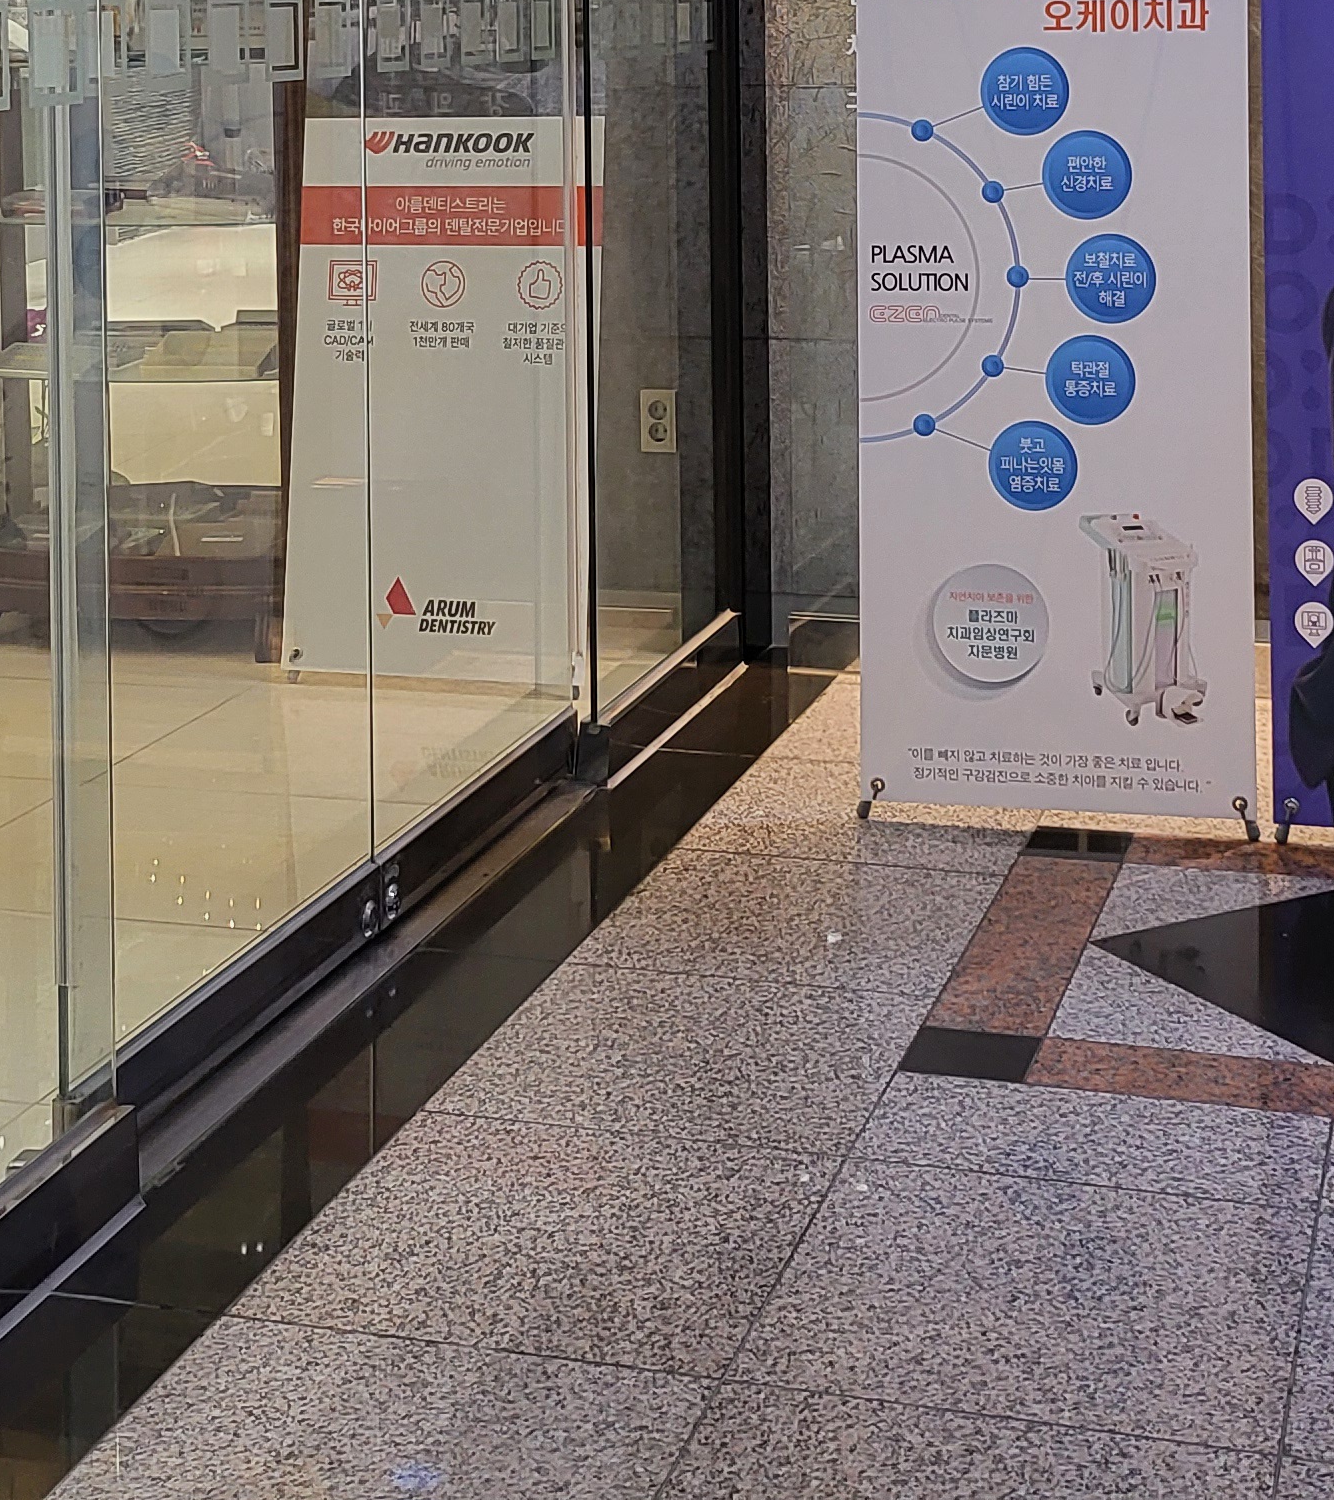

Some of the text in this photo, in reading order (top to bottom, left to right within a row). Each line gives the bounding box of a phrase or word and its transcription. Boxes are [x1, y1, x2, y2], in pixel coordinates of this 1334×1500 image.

[997, 75, 1053, 91] 참기 힘든
[991, 93, 1059, 110] 시린이 치료
[425, 156, 531, 170] driving emotion
[1067, 155, 1106, 173] 편안한
[1061, 175, 1114, 192] 신경치료
[395, 196, 507, 214] 아름덴티스트리는
[871, 245, 954, 265] PLASMA
[1083, 252, 1137, 268] 보철치료
[871, 272, 969, 292] SOLUTION
[1073, 270, 1147, 289] 전/후 시린이
[1098, 290, 1126, 308] 해결
[409, 321, 475, 333] 전세계 80개국
[413, 336, 470, 348] 1천만개 판매
[523, 352, 553, 365] 시스템
[1071, 361, 1110, 378] 턱관절
[1064, 380, 1117, 397] 통증치료
[1018, 437, 1045, 454] 붓고
[1000, 457, 1065, 474] 피나는잇몸
[1008, 475, 1061, 493] 염증치료
[422, 599, 477, 618] ARUM
[968, 610, 1018, 624] 플라즈마
[418, 618, 496, 637] DENTISTRY
[947, 626, 1034, 643] 치과임상연구회
[968, 644, 1018, 660] 자문병원
[938, 749, 960, 762] 빼지
[964, 750, 986, 762] 않고
[989, 751, 1036, 765] 치료하는
[1039, 753, 1062, 766] 것이
[1065, 755, 1088, 768] 가장
[1092, 756, 1115, 769] 좋은
[1118, 757, 1142, 770] 치료
[1145, 758, 1184, 773] 입니다.
[914, 767, 958, 781] 정기적인
[962, 768, 1031, 783] 구강검진으로
[1034, 772, 1069, 787] 소중한
[1072, 774, 1106, 788] 치아를
[1111, 776, 1133, 790] 지킬
[1137, 777, 1149, 790] 수
